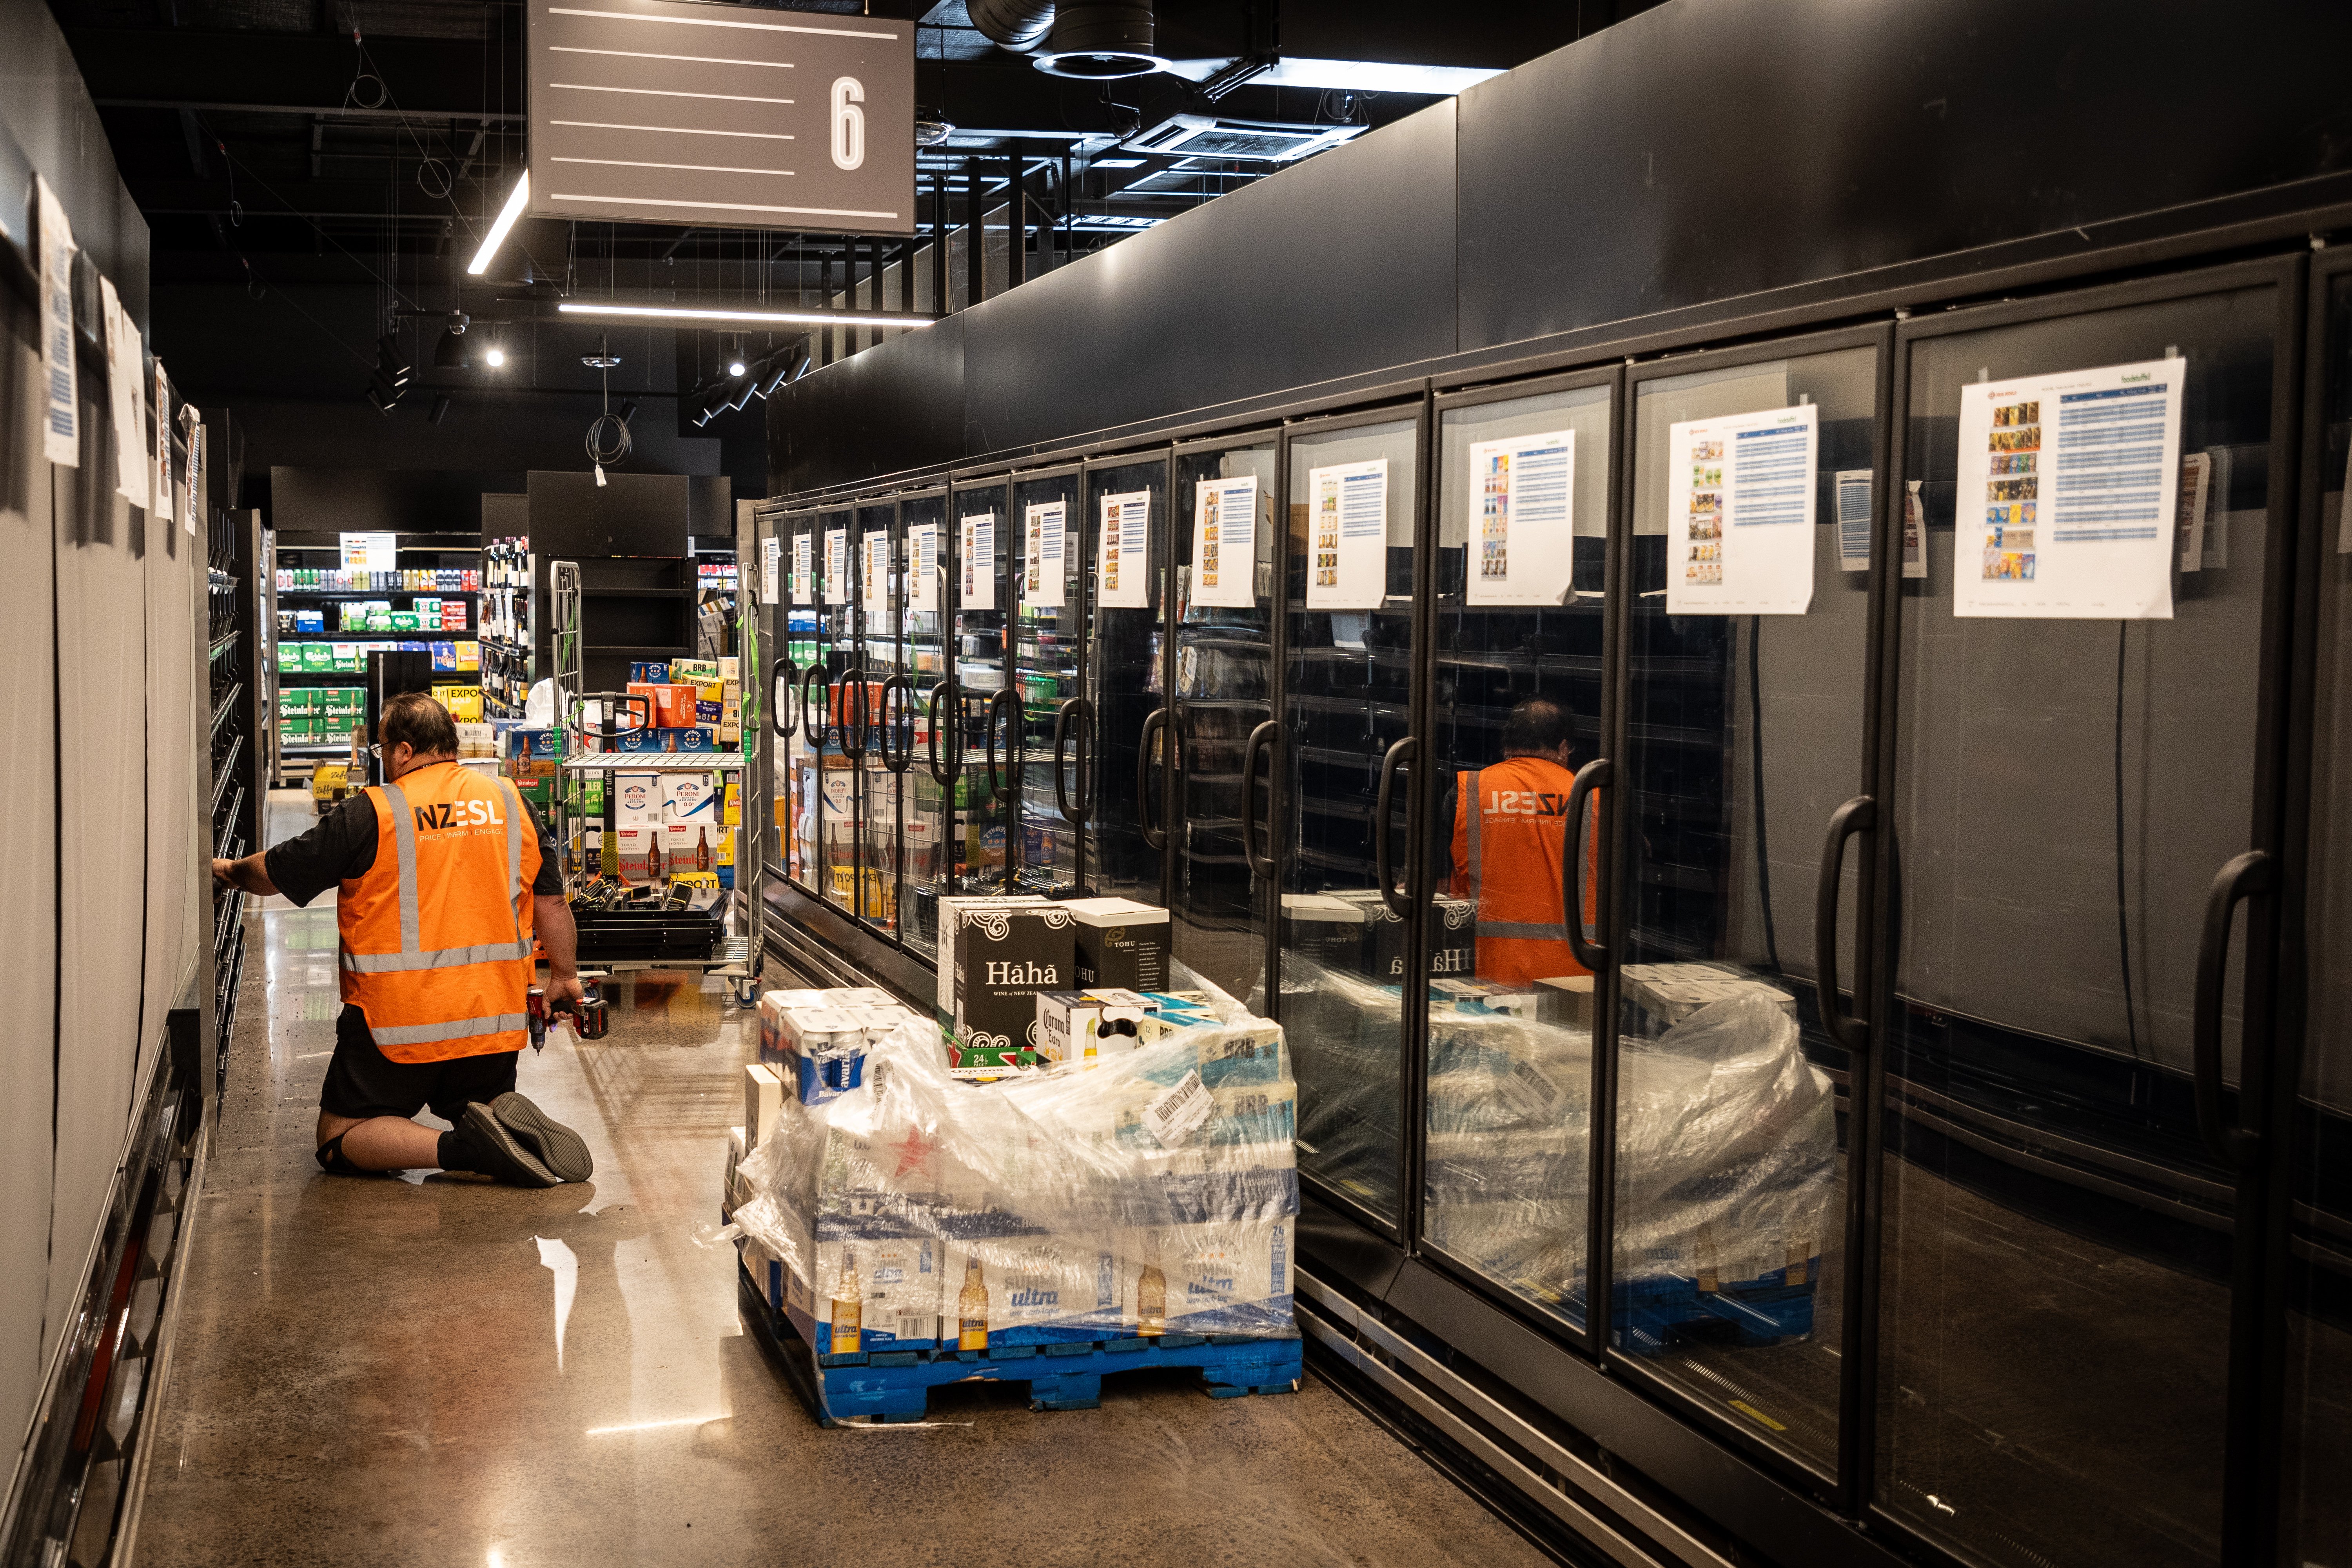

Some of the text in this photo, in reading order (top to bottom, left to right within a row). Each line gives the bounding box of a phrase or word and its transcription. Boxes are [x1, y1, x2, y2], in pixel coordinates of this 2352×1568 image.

[831, 76, 864, 170] 6
[436, 656, 456, 666] Tiger
[691, 679, 717, 689] EXPORT
[279, 704, 321, 717] Steinlaer
[325, 704, 363, 717] Steinlaer
[539, 732, 554, 740] SPEIGH
[607, 787, 612, 795] BT
[414, 800, 503, 831] NZESL
[419, 833, 441, 842] PRICE
[1075, 965, 1094, 983] OHU
[1043, 1008, 1065, 1038] Corona
[1047, 1027, 1060, 1047] Extra
[973, 1054, 984, 1063] 24
[841, 1051, 850, 1089] avaria
[818, 1223, 861, 1232] Heineken
[1011, 1287, 1058, 1307] ultra
[835, 1324, 857, 1333] ultra
[962, 1319, 985, 1328] ultra
